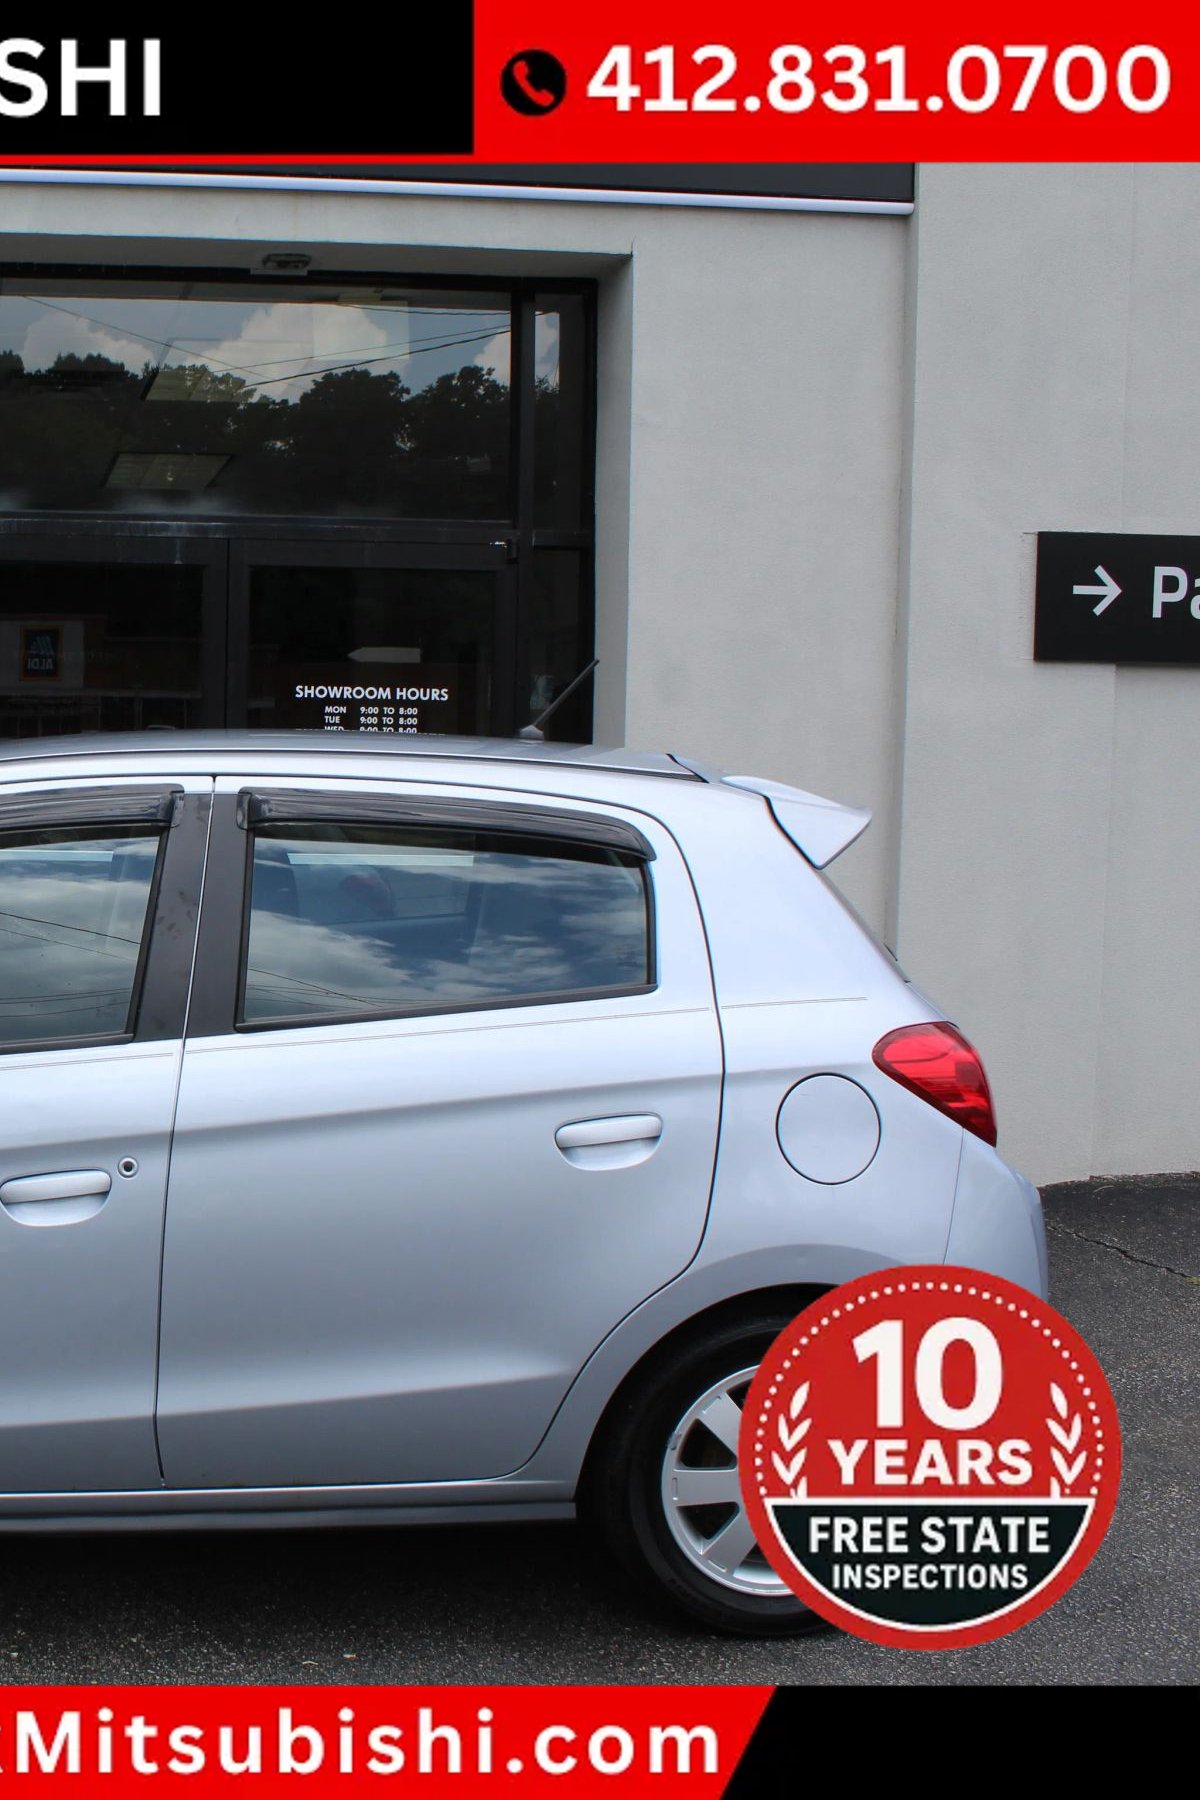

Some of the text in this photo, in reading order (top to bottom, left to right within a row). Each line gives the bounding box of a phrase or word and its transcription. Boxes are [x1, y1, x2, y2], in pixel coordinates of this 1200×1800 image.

[295, 684, 449, 701] SHOWROOM HOURS
[324, 706, 347, 714] MON
[360, 706, 379, 715] 9:00
[398, 707, 418, 715] 8:00
[324, 716, 341, 724] TUE
[360, 716, 378, 725] 9:00
[398, 717, 418, 725] 8:00
